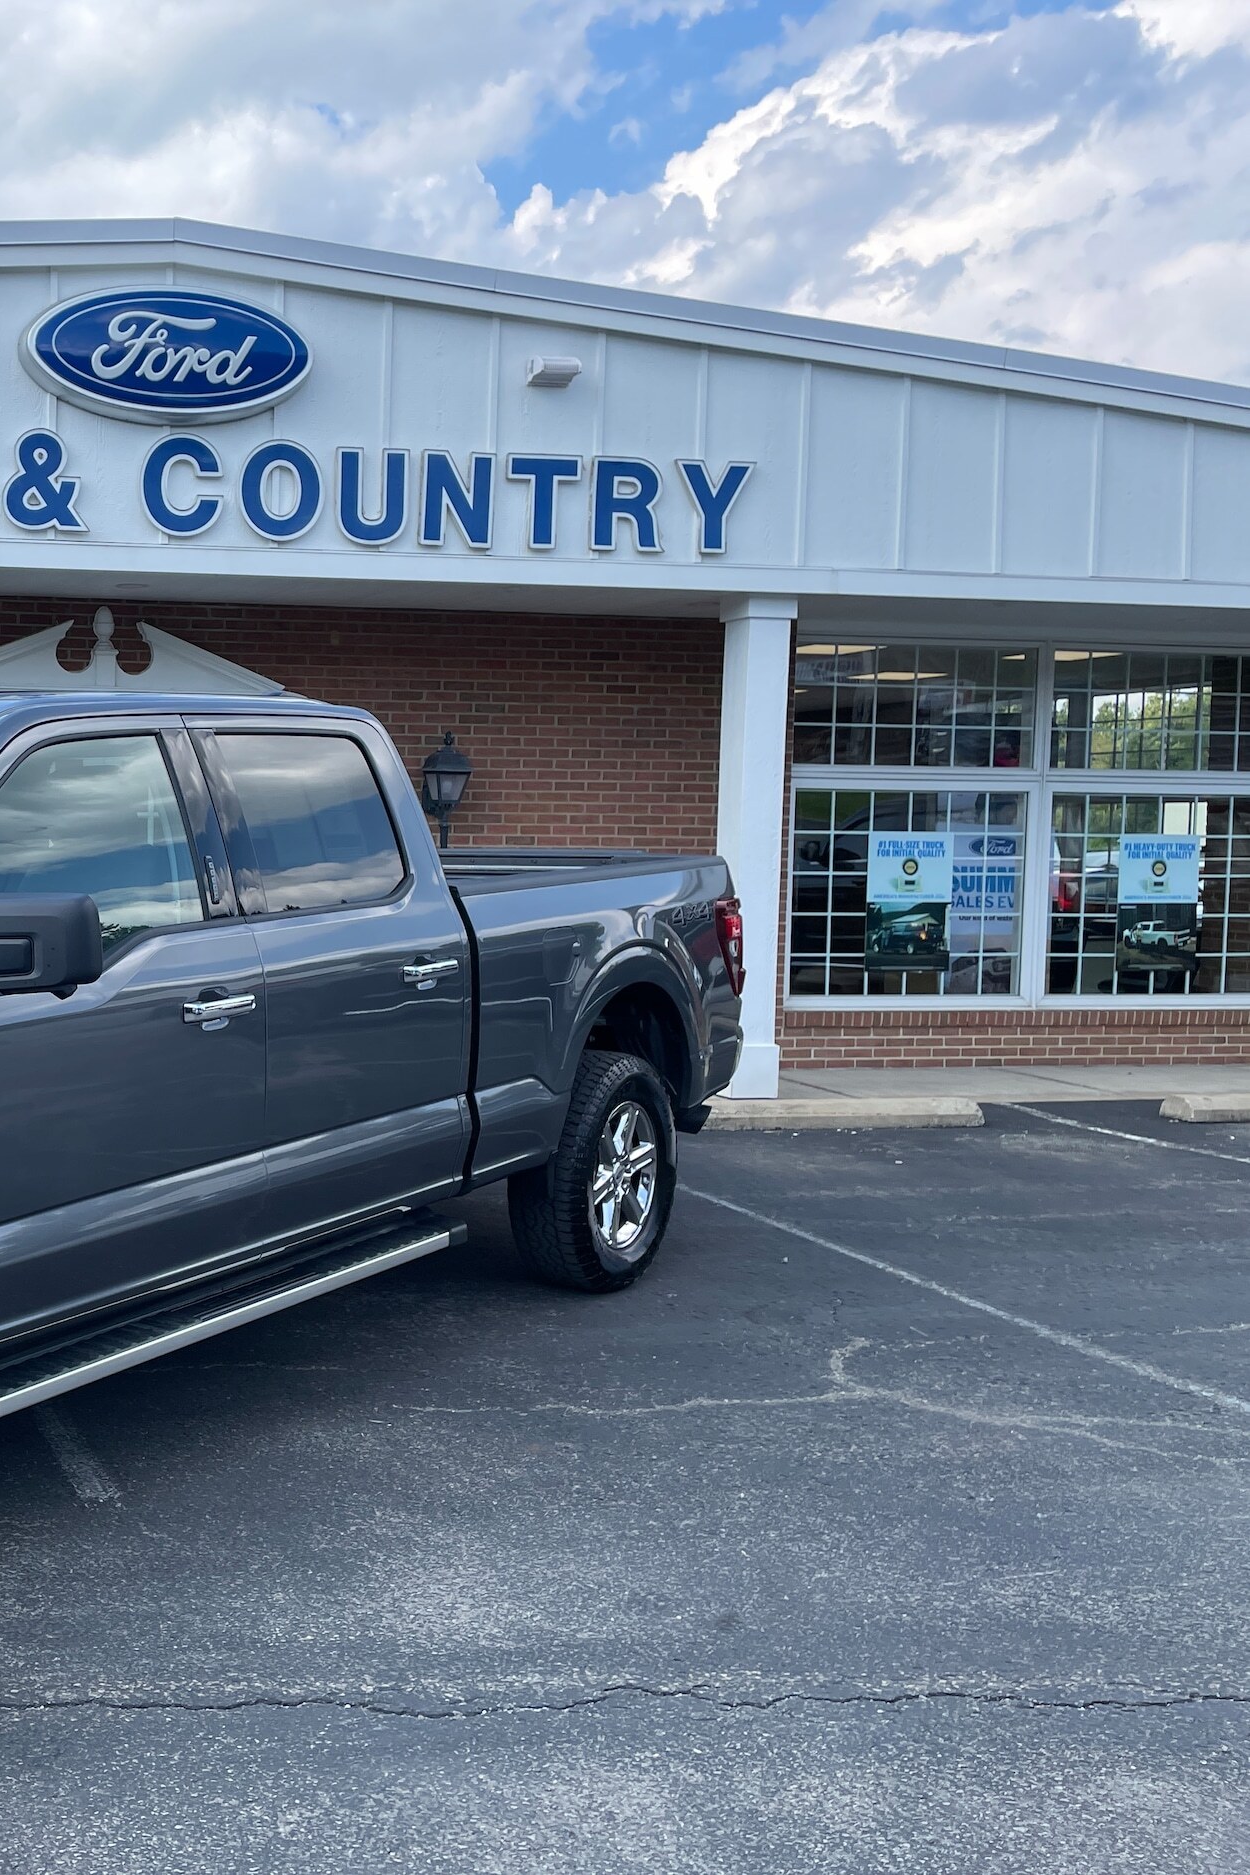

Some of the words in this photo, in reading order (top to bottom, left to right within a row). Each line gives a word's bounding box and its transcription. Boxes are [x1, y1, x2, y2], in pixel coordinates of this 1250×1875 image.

[91, 311, 258, 386] Ford
[3, 428, 90, 533] &
[140, 432, 757, 554] COUNTRY
[917, 849, 947, 859] QUALITY
